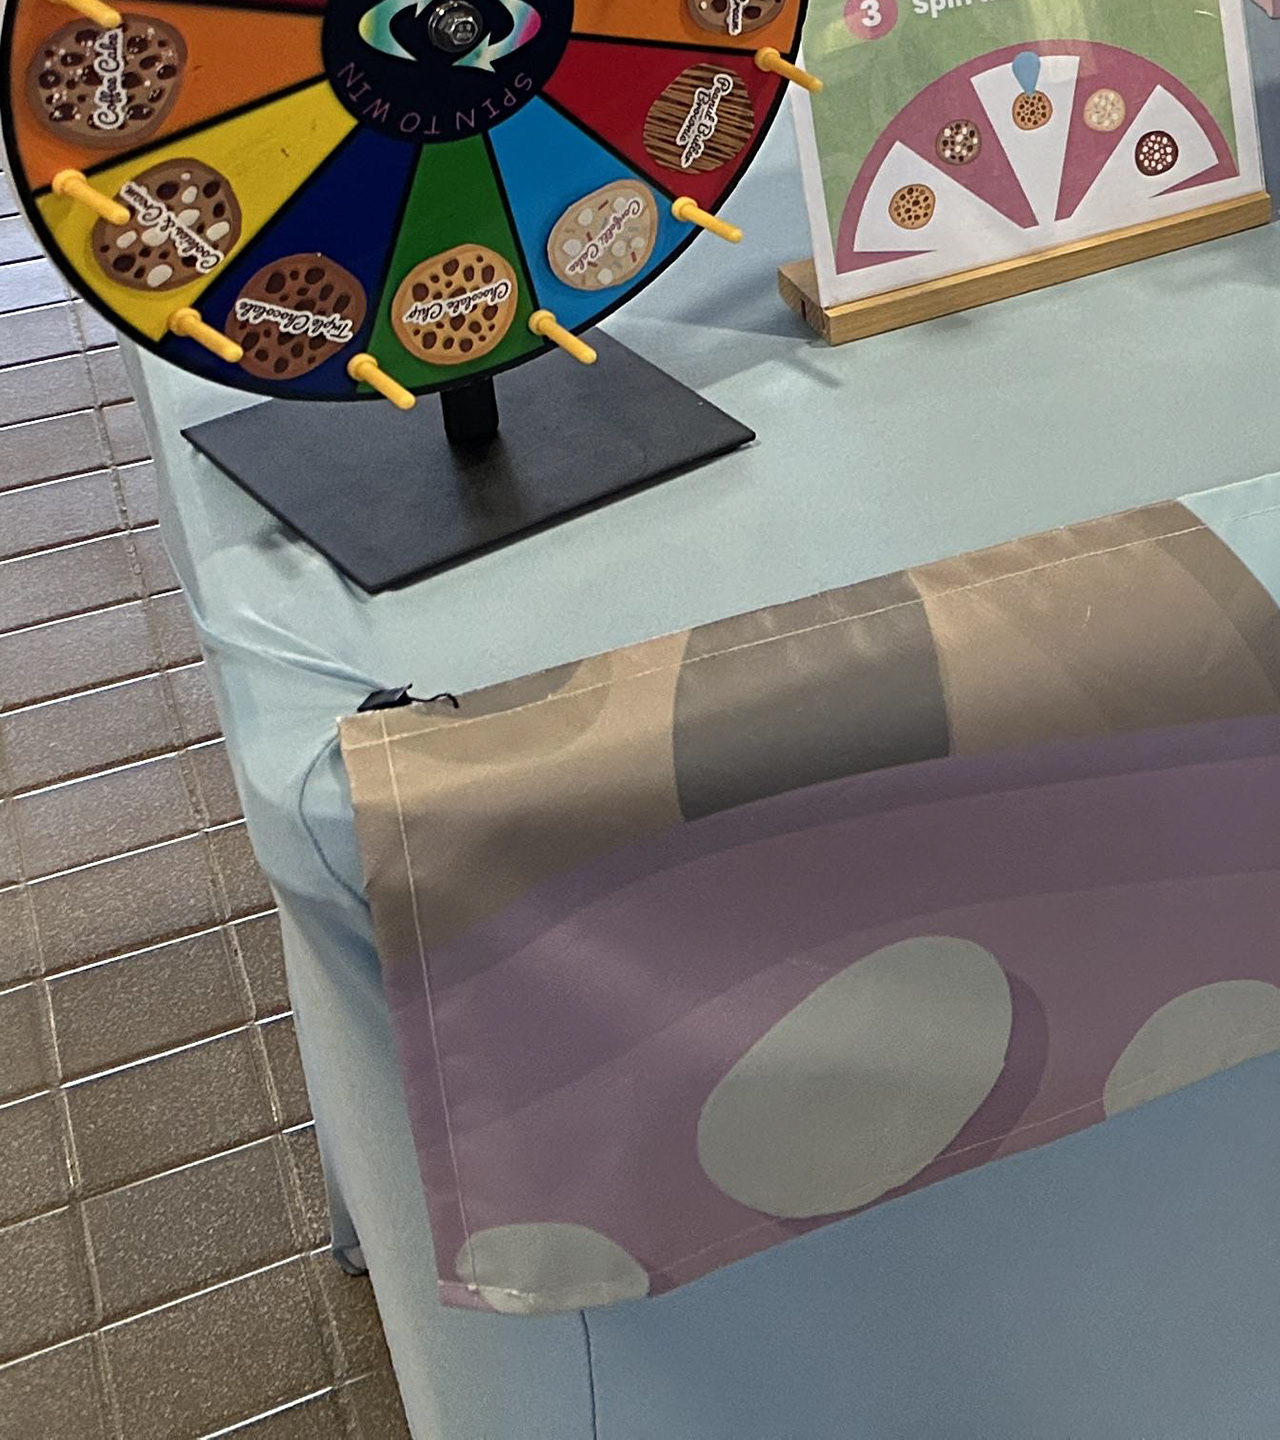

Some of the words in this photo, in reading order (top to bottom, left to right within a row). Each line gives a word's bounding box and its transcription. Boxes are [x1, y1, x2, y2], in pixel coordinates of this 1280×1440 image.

[97, 32, 120, 73] Cake
[97, 77, 122, 126] Coffee
[337, 61, 392, 123] WIN
[455, 72, 533, 131] SPIN
[704, 76, 731, 123] Peanut
[400, 111, 441, 135] TO
[683, 122, 713, 164] Butter
[124, 185, 163, 222] Cream
[600, 200, 641, 246] Confetti
[175, 226, 220, 270] Cookies
[568, 243, 599, 271] Cake
[239, 301, 310, 330] Chocolate
[406, 302, 443, 322] Chip
[446, 282, 509, 314] Chocolate
[312, 316, 350, 339] Triple
